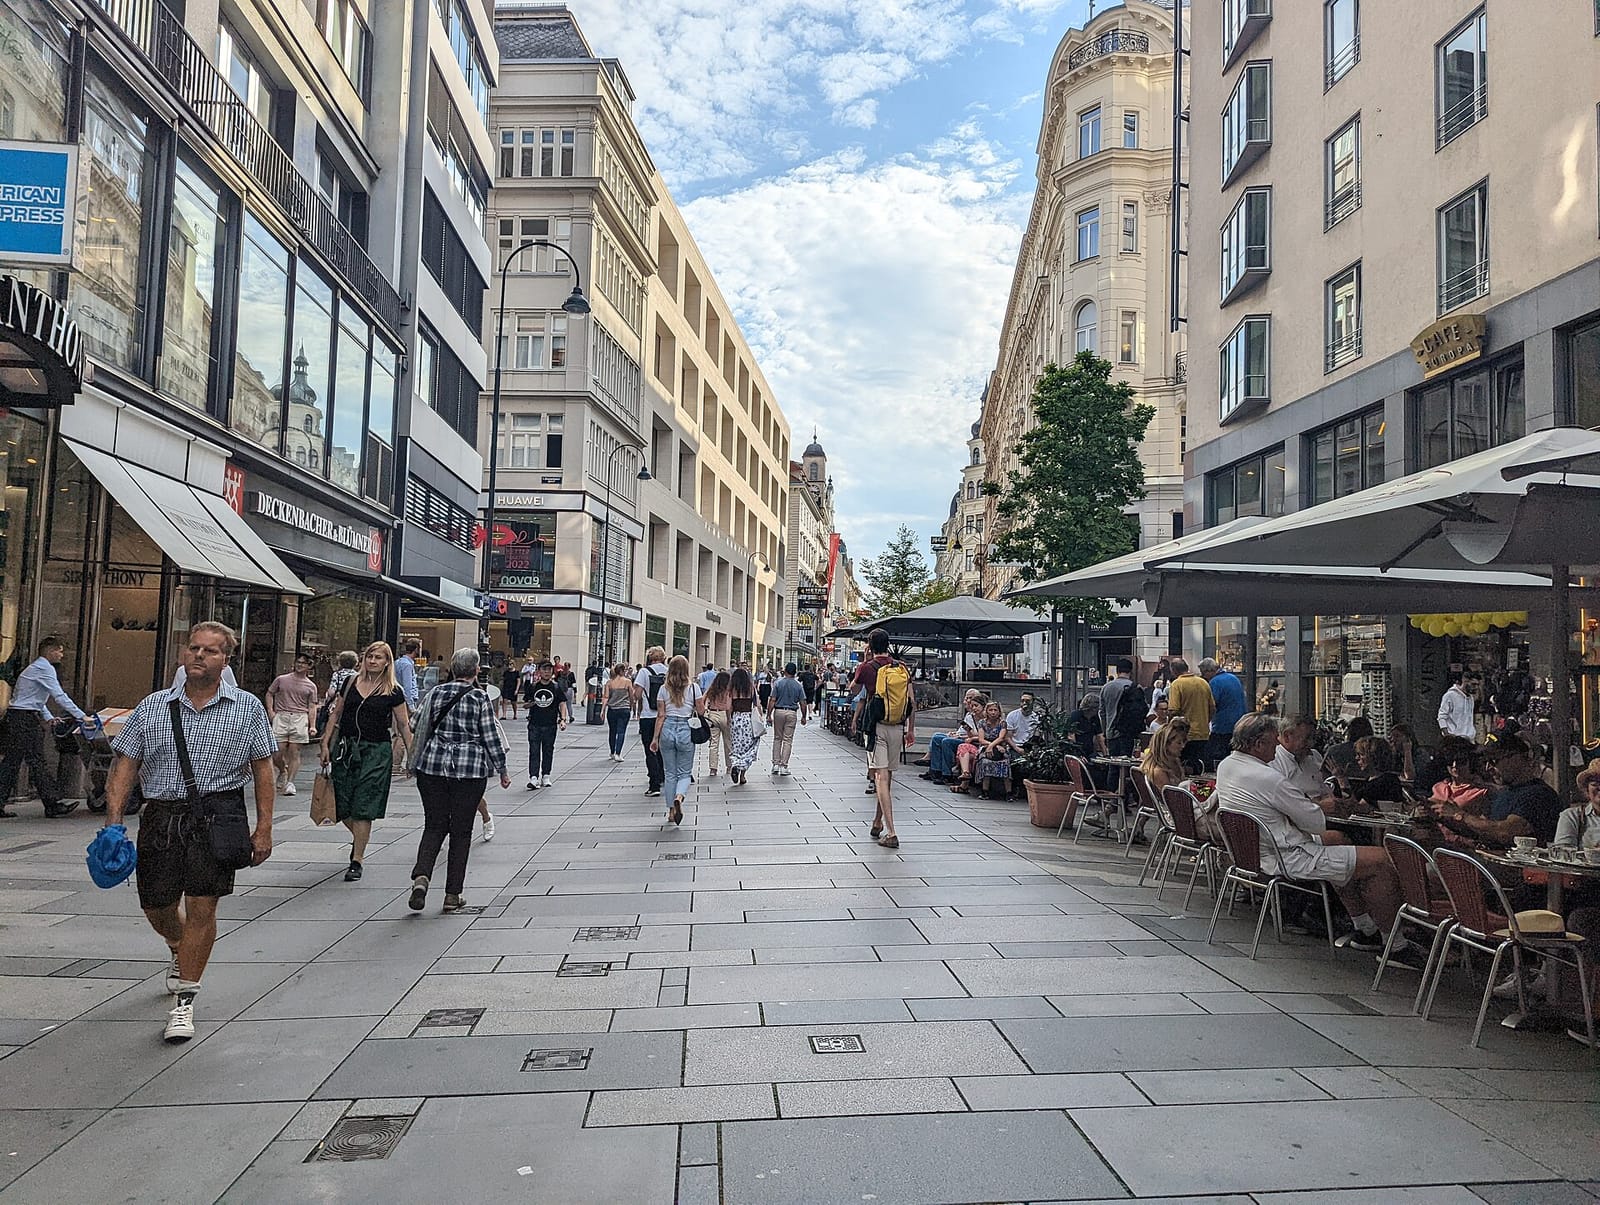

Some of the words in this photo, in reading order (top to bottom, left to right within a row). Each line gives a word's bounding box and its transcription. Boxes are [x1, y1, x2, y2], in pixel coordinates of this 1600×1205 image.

[0, 184, 61, 204] RICAN
[0, 205, 65, 225] PRESS
[0, 275, 83, 384] NTHON
[1424, 342, 1475, 369] EUROPA
[498, 495, 545, 506] HUAWEI
[257, 491, 333, 541] DECKENBACHER
[505, 560, 530, 569] 2022
[86, 571, 147, 587] ATHONY
